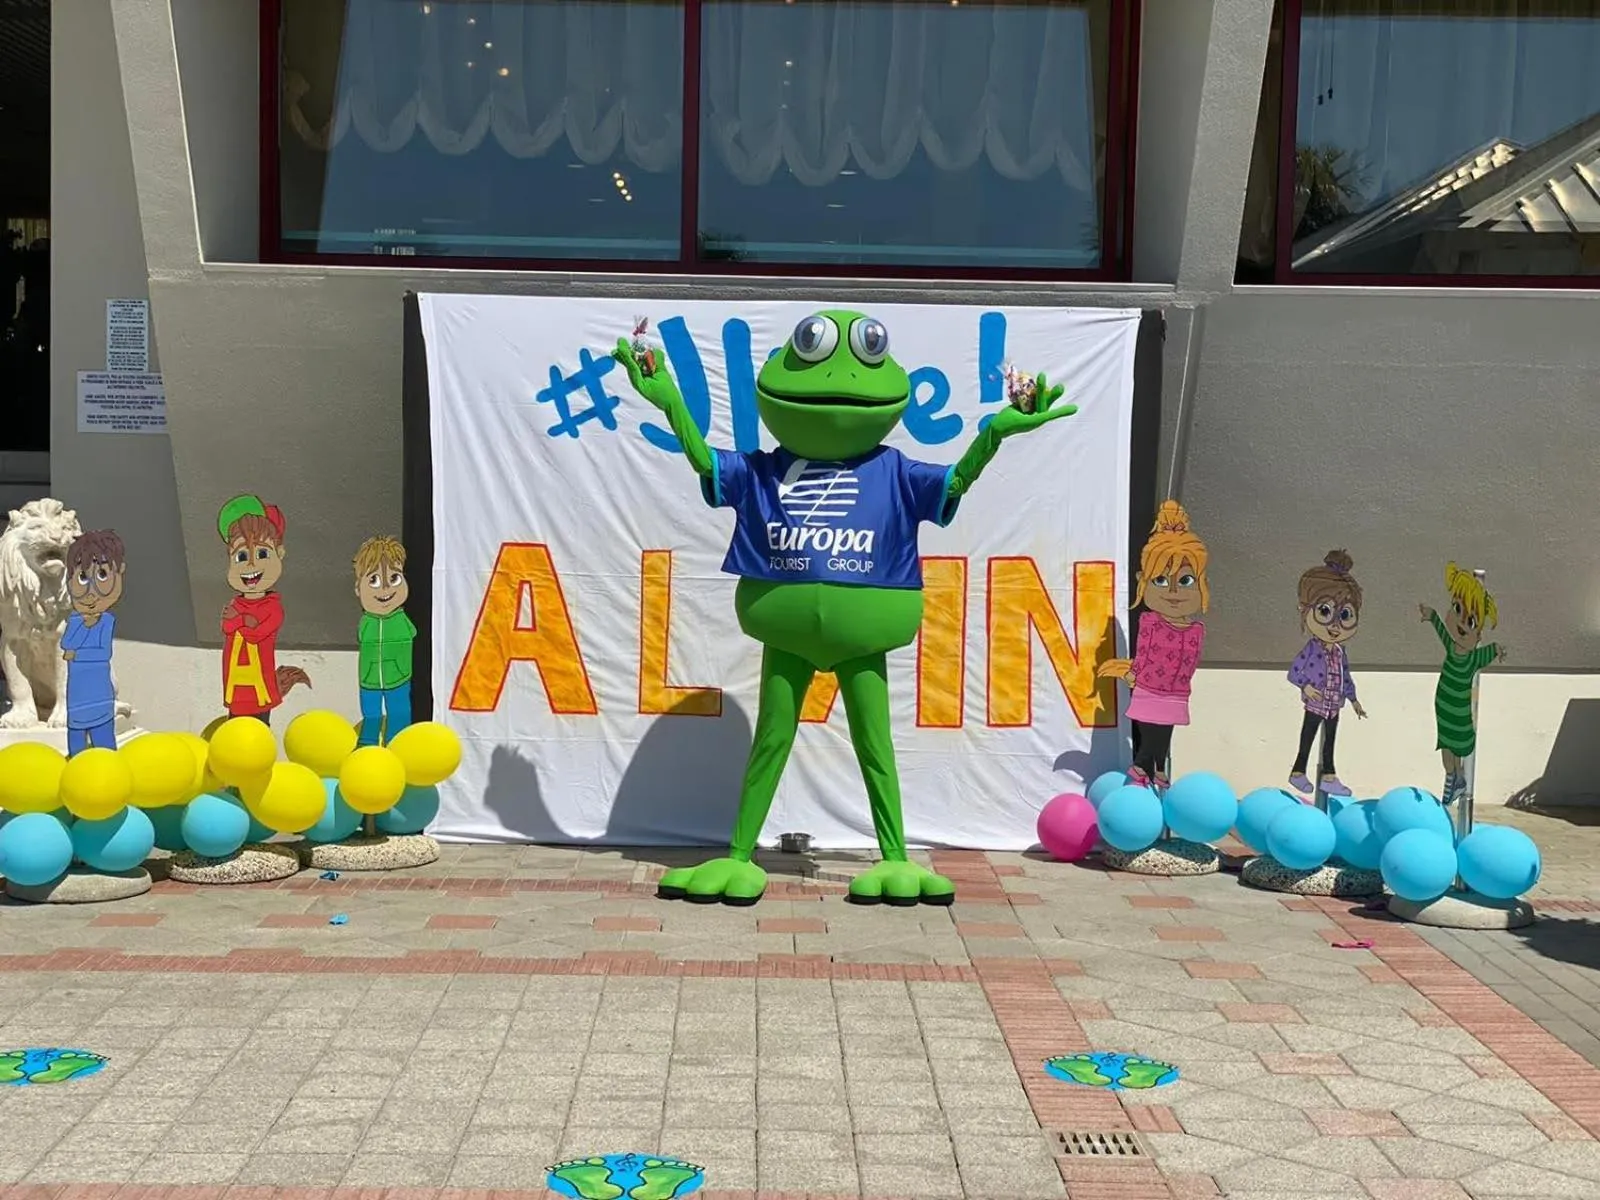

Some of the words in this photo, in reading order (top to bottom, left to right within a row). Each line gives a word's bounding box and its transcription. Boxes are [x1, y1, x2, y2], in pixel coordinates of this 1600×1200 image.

[767, 521, 875, 556] Europa
[769, 556, 811, 571] TOURIST
[827, 557, 874, 573] GROUP
[449, 543, 1118, 728] ALIN
[225, 630, 272, 706] A
